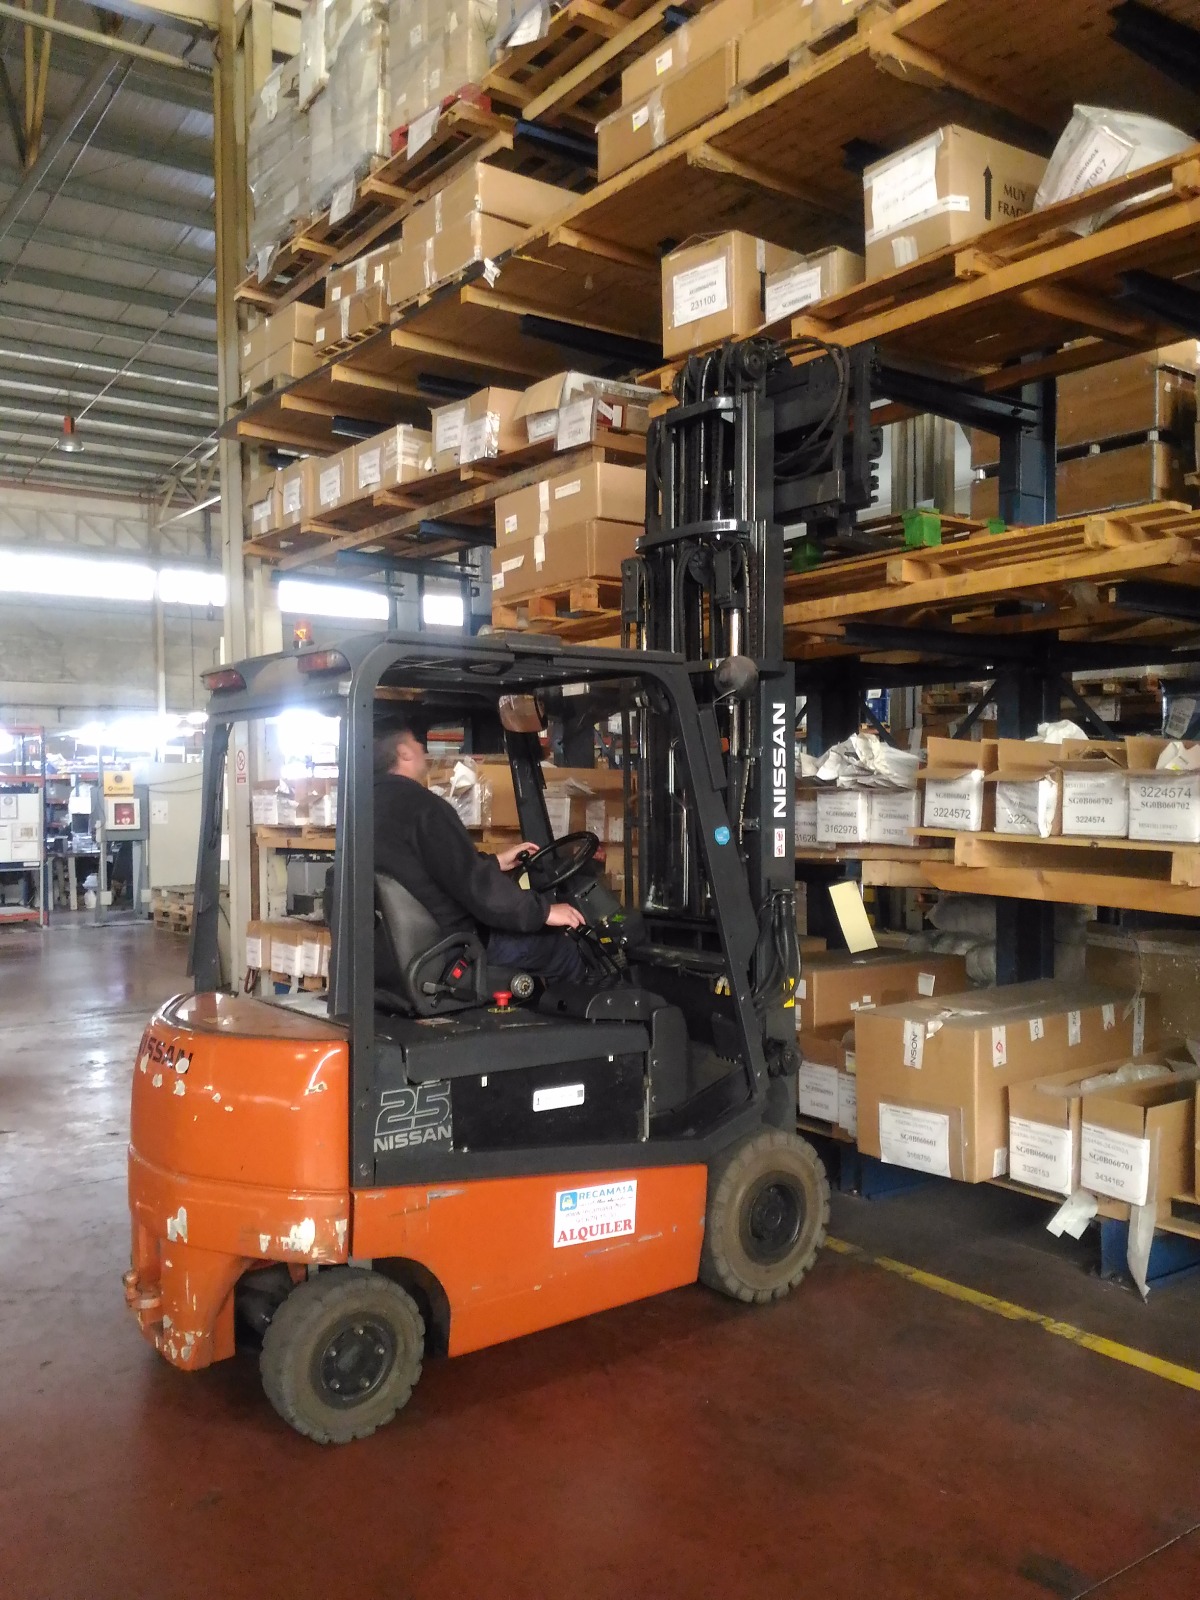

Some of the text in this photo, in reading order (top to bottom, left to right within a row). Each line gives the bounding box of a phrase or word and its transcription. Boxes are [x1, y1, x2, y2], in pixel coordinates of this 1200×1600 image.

[1003, 184, 1027, 202] MUY
[690, 295, 716, 312] 231100
[772, 702, 787, 818] NISSAN
[1140, 786, 1192, 799] 3224574
[1068, 797, 1113, 805] SG0B060702
[1141, 801, 1191, 810] SG0B060702
[933, 807, 971, 820] 3224572
[1075, 816, 1106, 824] 3224574
[824, 824, 858, 835] 3162978
[375, 1080, 452, 1137] 25
[373, 1125, 453, 1153] NISSAN
[1089, 1151, 1134, 1172] SG0B060701
[579, 1184, 634, 1200] RECAMASA
[557, 1218, 633, 1243] ALQUILER
